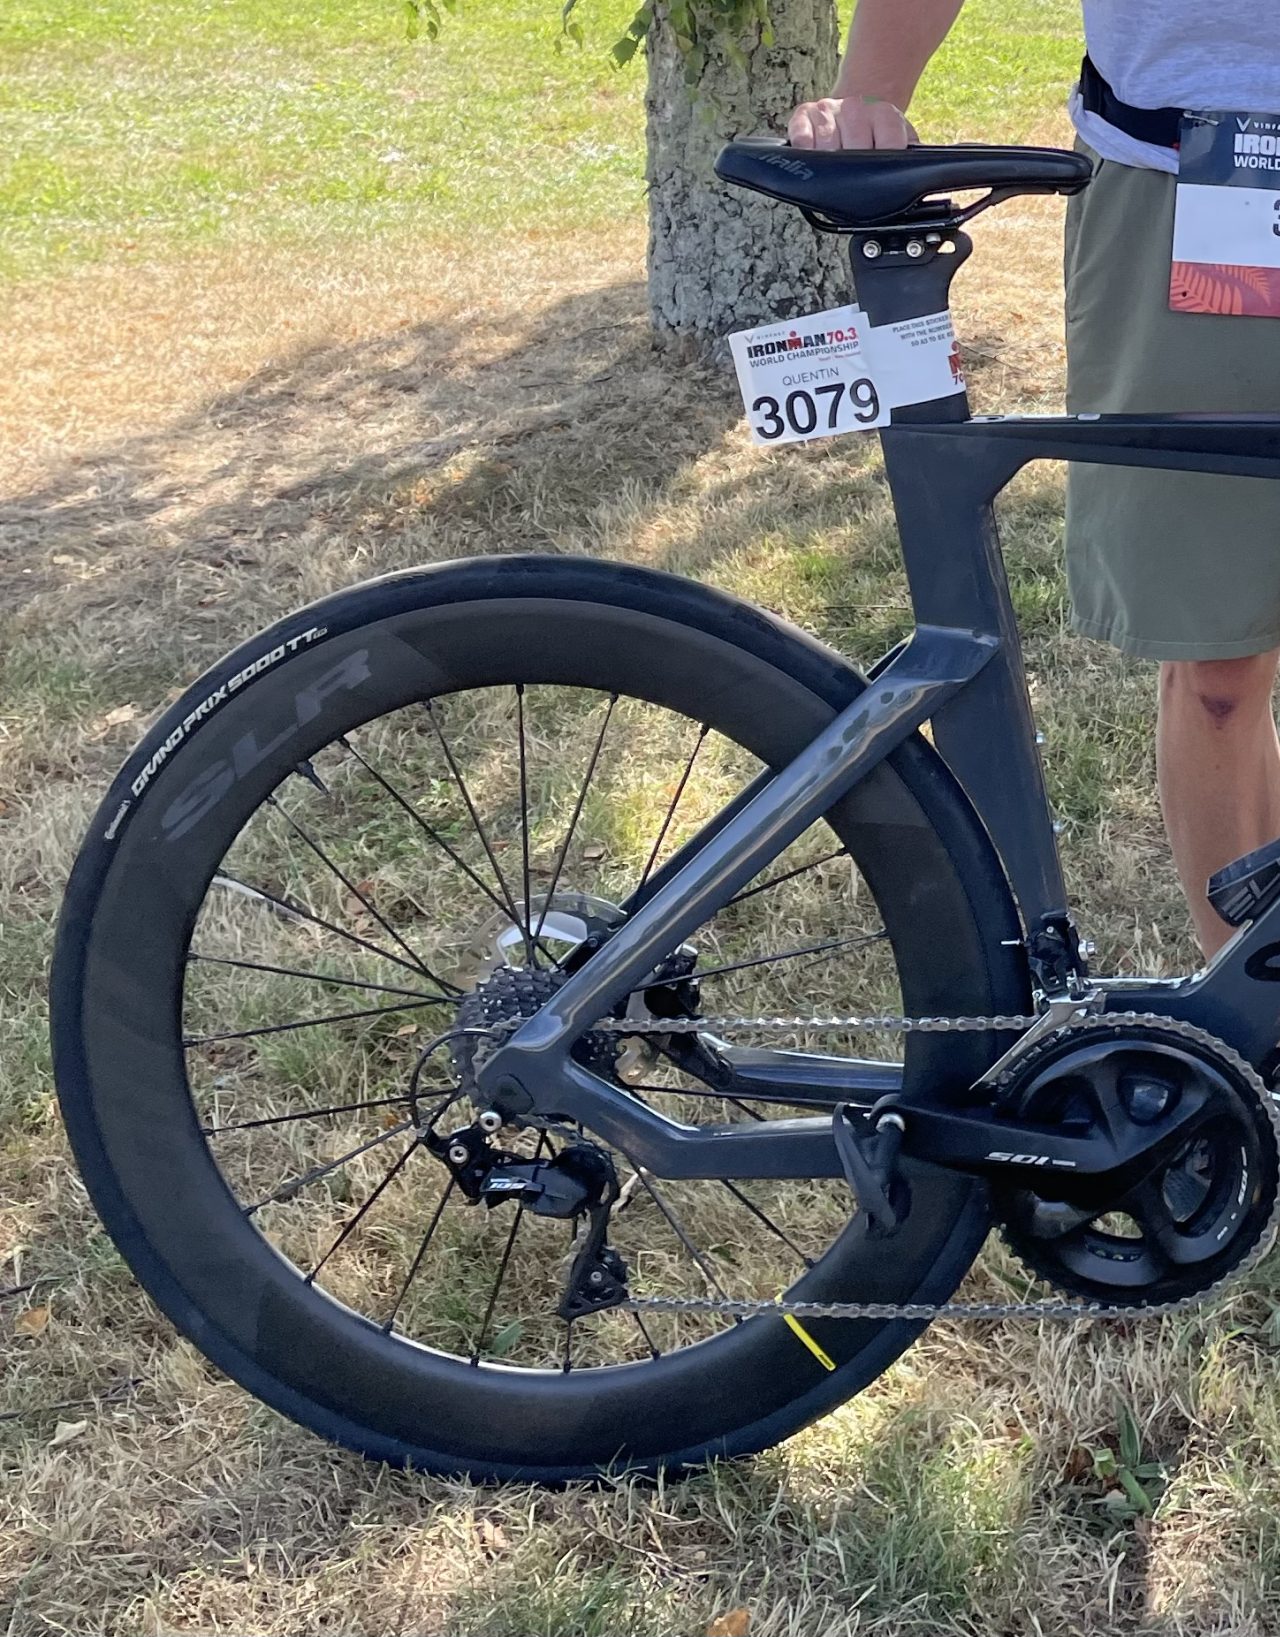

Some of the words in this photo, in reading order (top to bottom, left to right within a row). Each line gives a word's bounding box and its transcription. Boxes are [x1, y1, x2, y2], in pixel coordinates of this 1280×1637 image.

[747, 331, 826, 359] IRONMAN
[827, 327, 858, 345] 70.3
[749, 354, 785, 368] WORLD
[787, 341, 859, 361] CHAMPIONSHIP
[782, 367, 840, 387] QUENTIN
[752, 378, 880, 440] 3079
[130, 726, 184, 797] GRAND
[182, 684, 228, 733] PRIX
[227, 644, 286, 693] 5000
[161, 650, 372, 842] SLR
